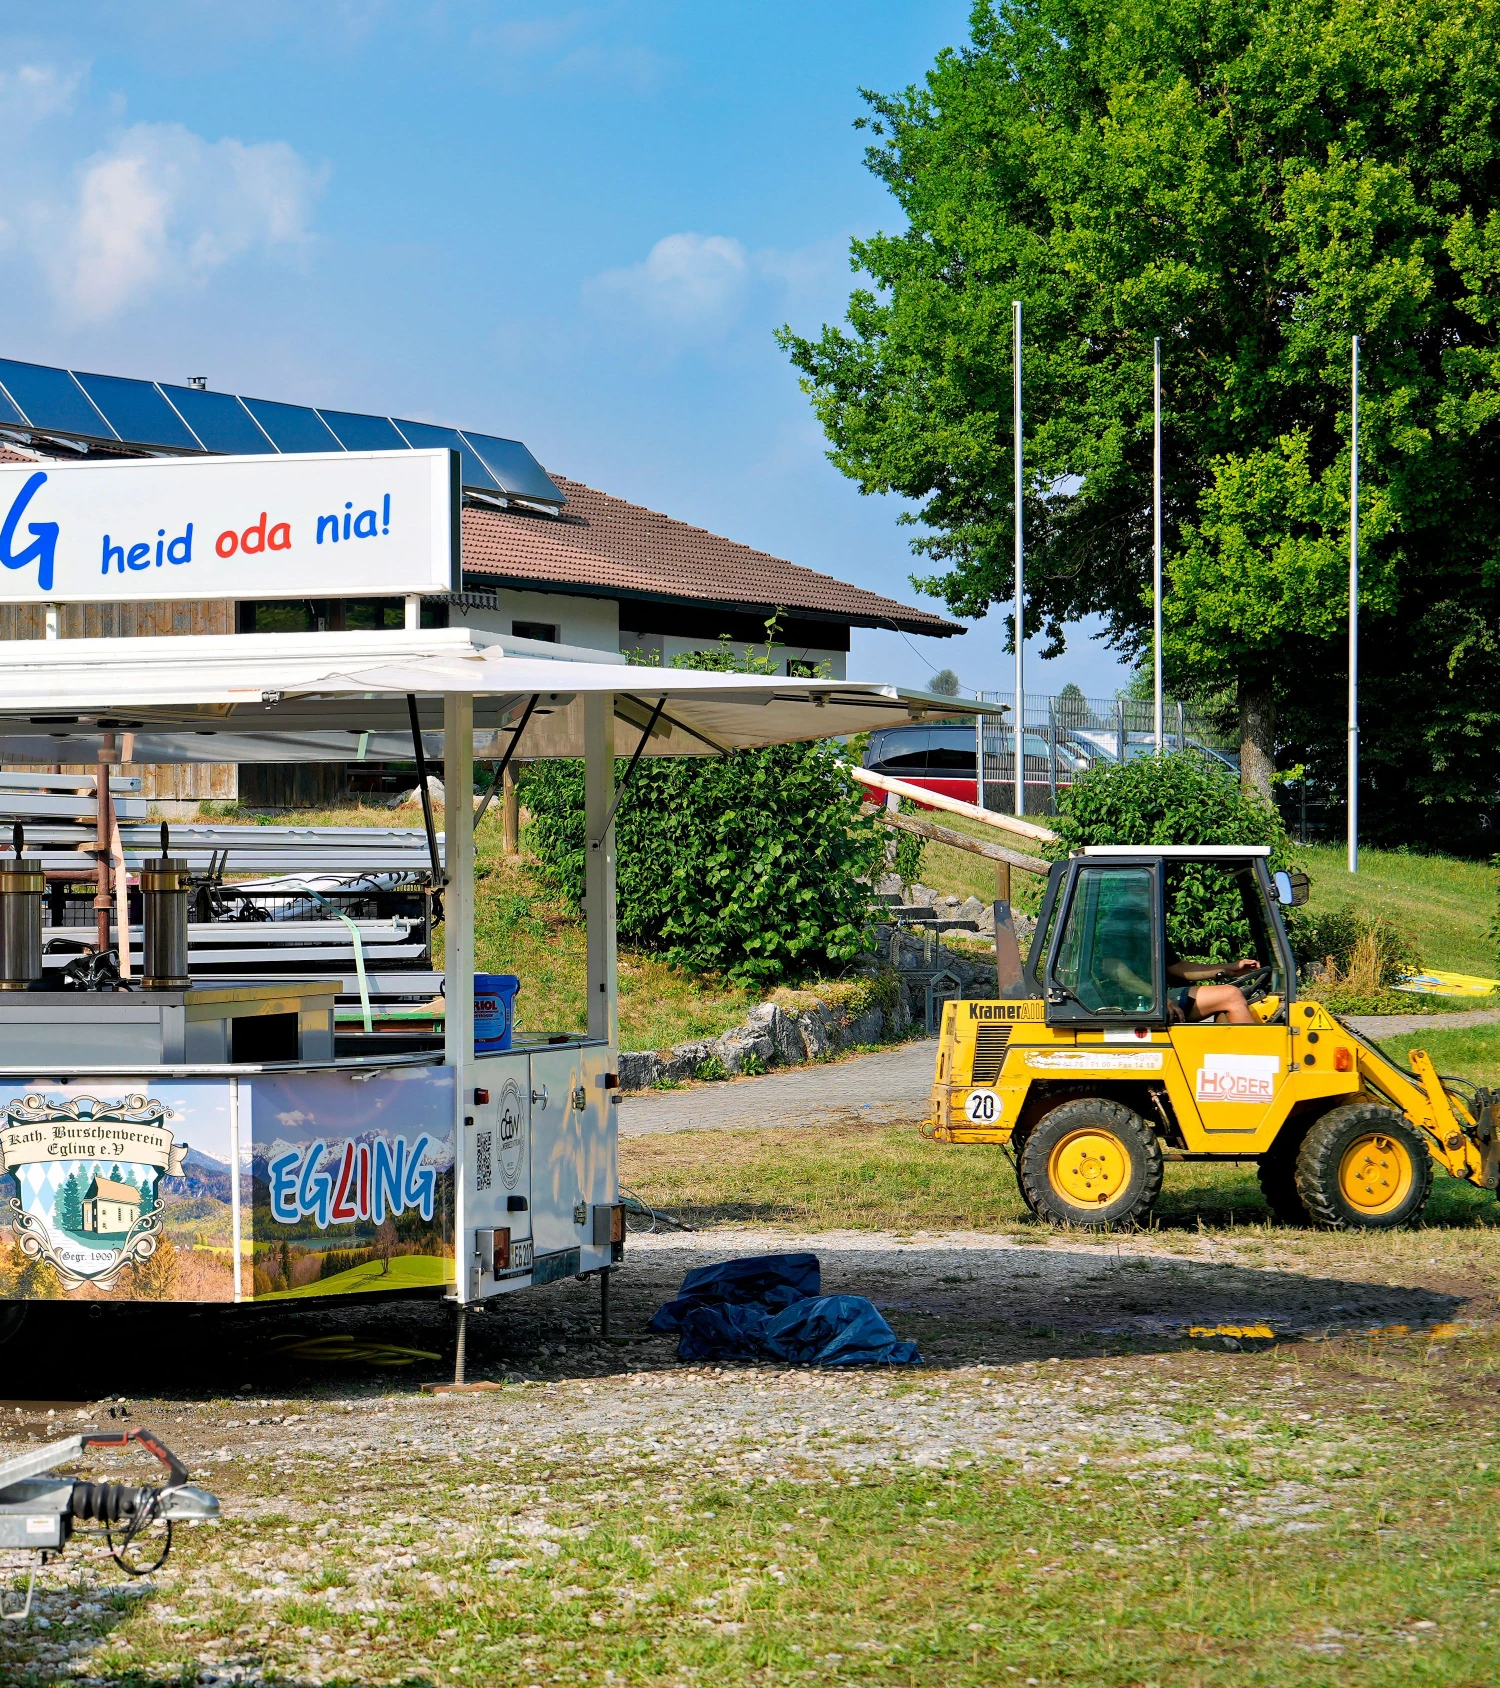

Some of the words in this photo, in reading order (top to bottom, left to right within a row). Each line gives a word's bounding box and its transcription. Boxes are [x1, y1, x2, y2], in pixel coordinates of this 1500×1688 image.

[101, 522, 194, 575] heid
[215, 511, 292, 559] oda
[315, 493, 391, 545] nia!
[1118, 1061, 1132, 1069] Fax
[1134, 1053, 1159, 1062] Egling
[1200, 1071, 1270, 1095] HÖGER
[972, 1094, 994, 1120] 20
[8, 1130, 47, 1147] Kath.
[52, 1126, 164, 1147] Burschenverein
[47, 1142, 96, 1156] Egling
[271, 1136, 434, 1226] EGLING
[62, 1251, 87, 1263] Gegr.
